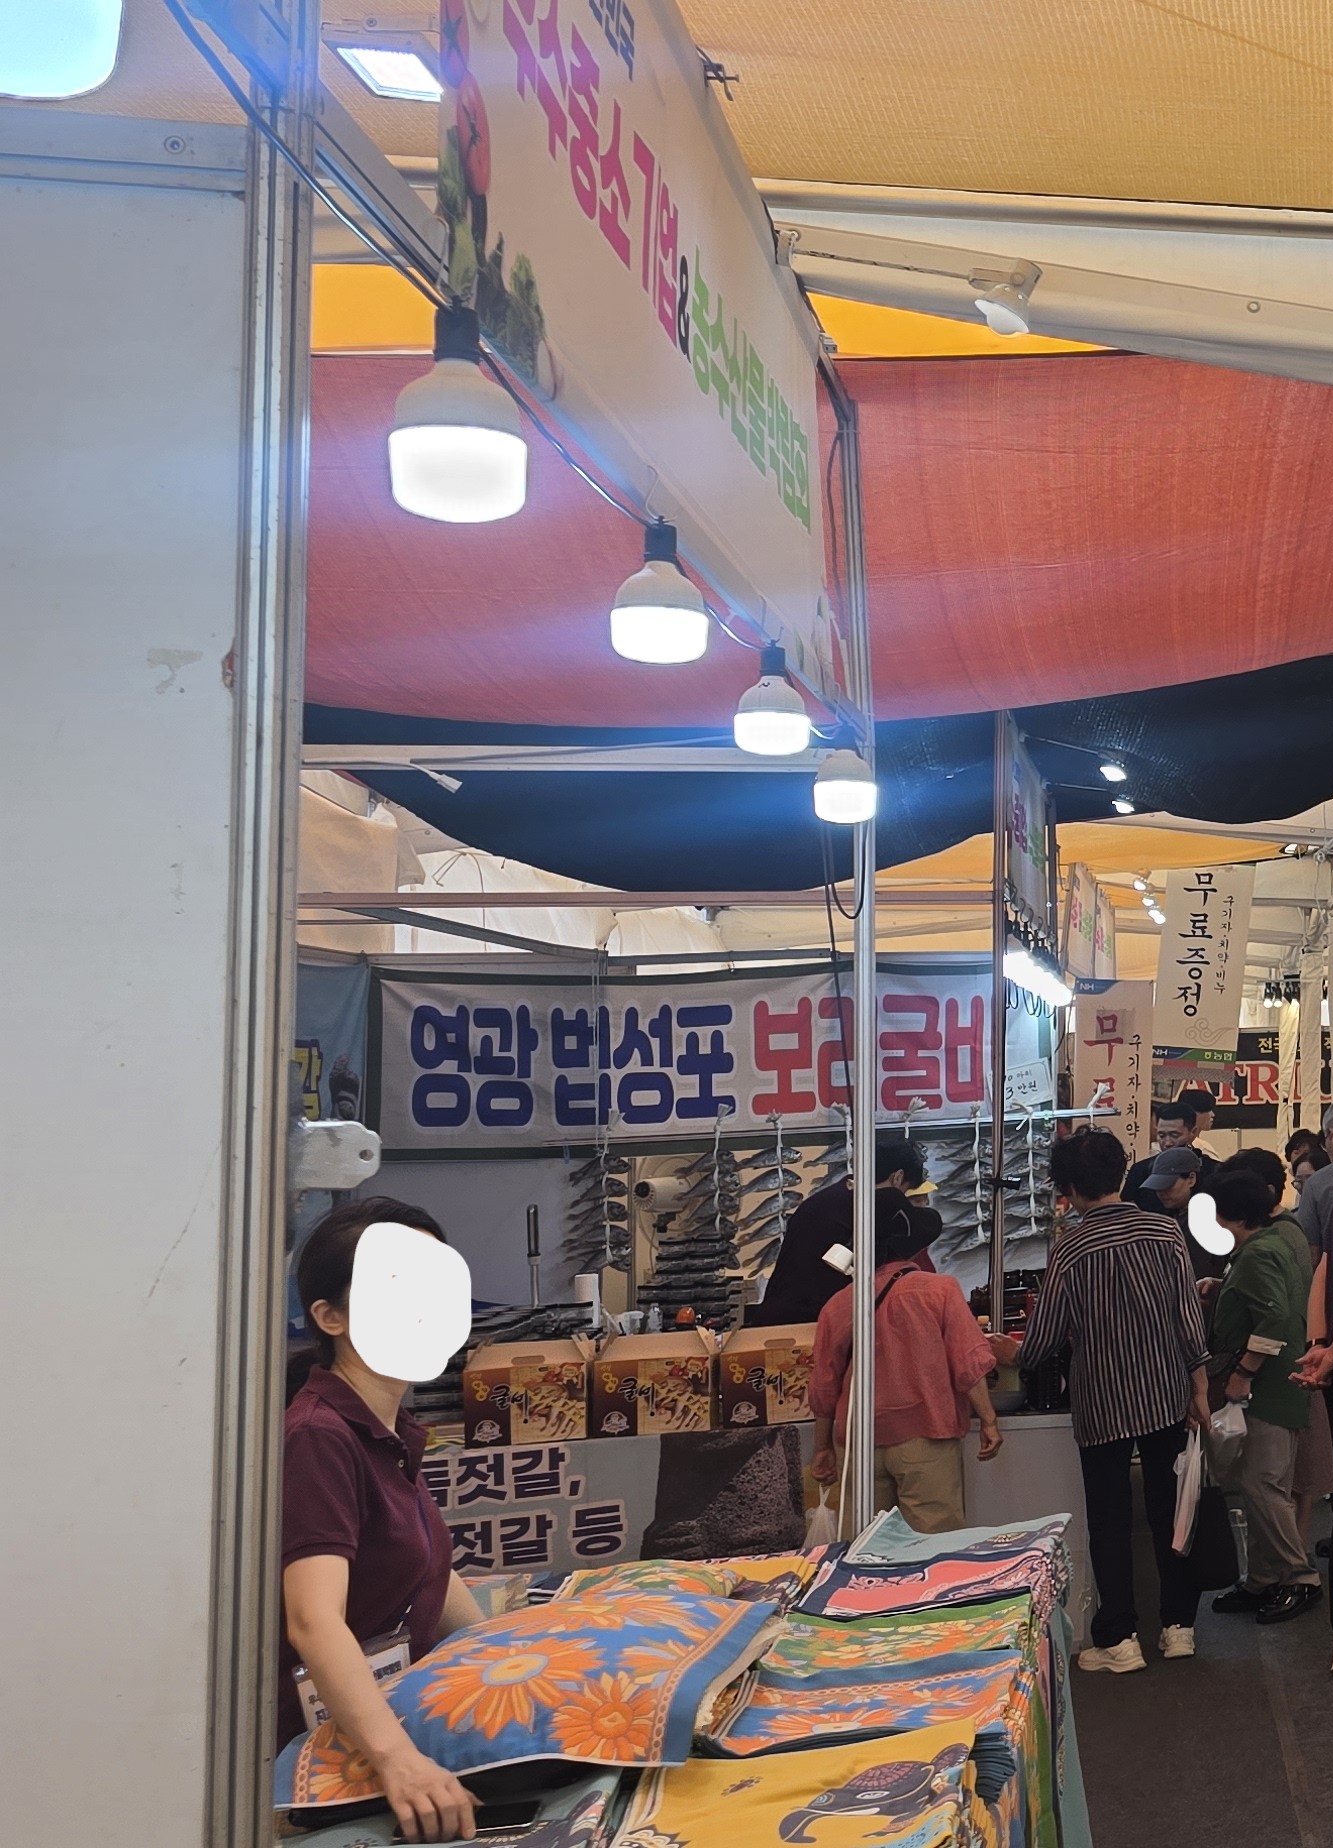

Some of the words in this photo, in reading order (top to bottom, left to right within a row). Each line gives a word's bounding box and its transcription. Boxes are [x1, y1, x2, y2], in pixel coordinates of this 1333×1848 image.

[1079, 983, 1094, 991] NH
[1173, 873, 1217, 1017] 무료증정
[410, 1003, 539, 1128] 영광
[552, 1003, 737, 1127] 법성포
[572, 1504, 624, 1556] 등
